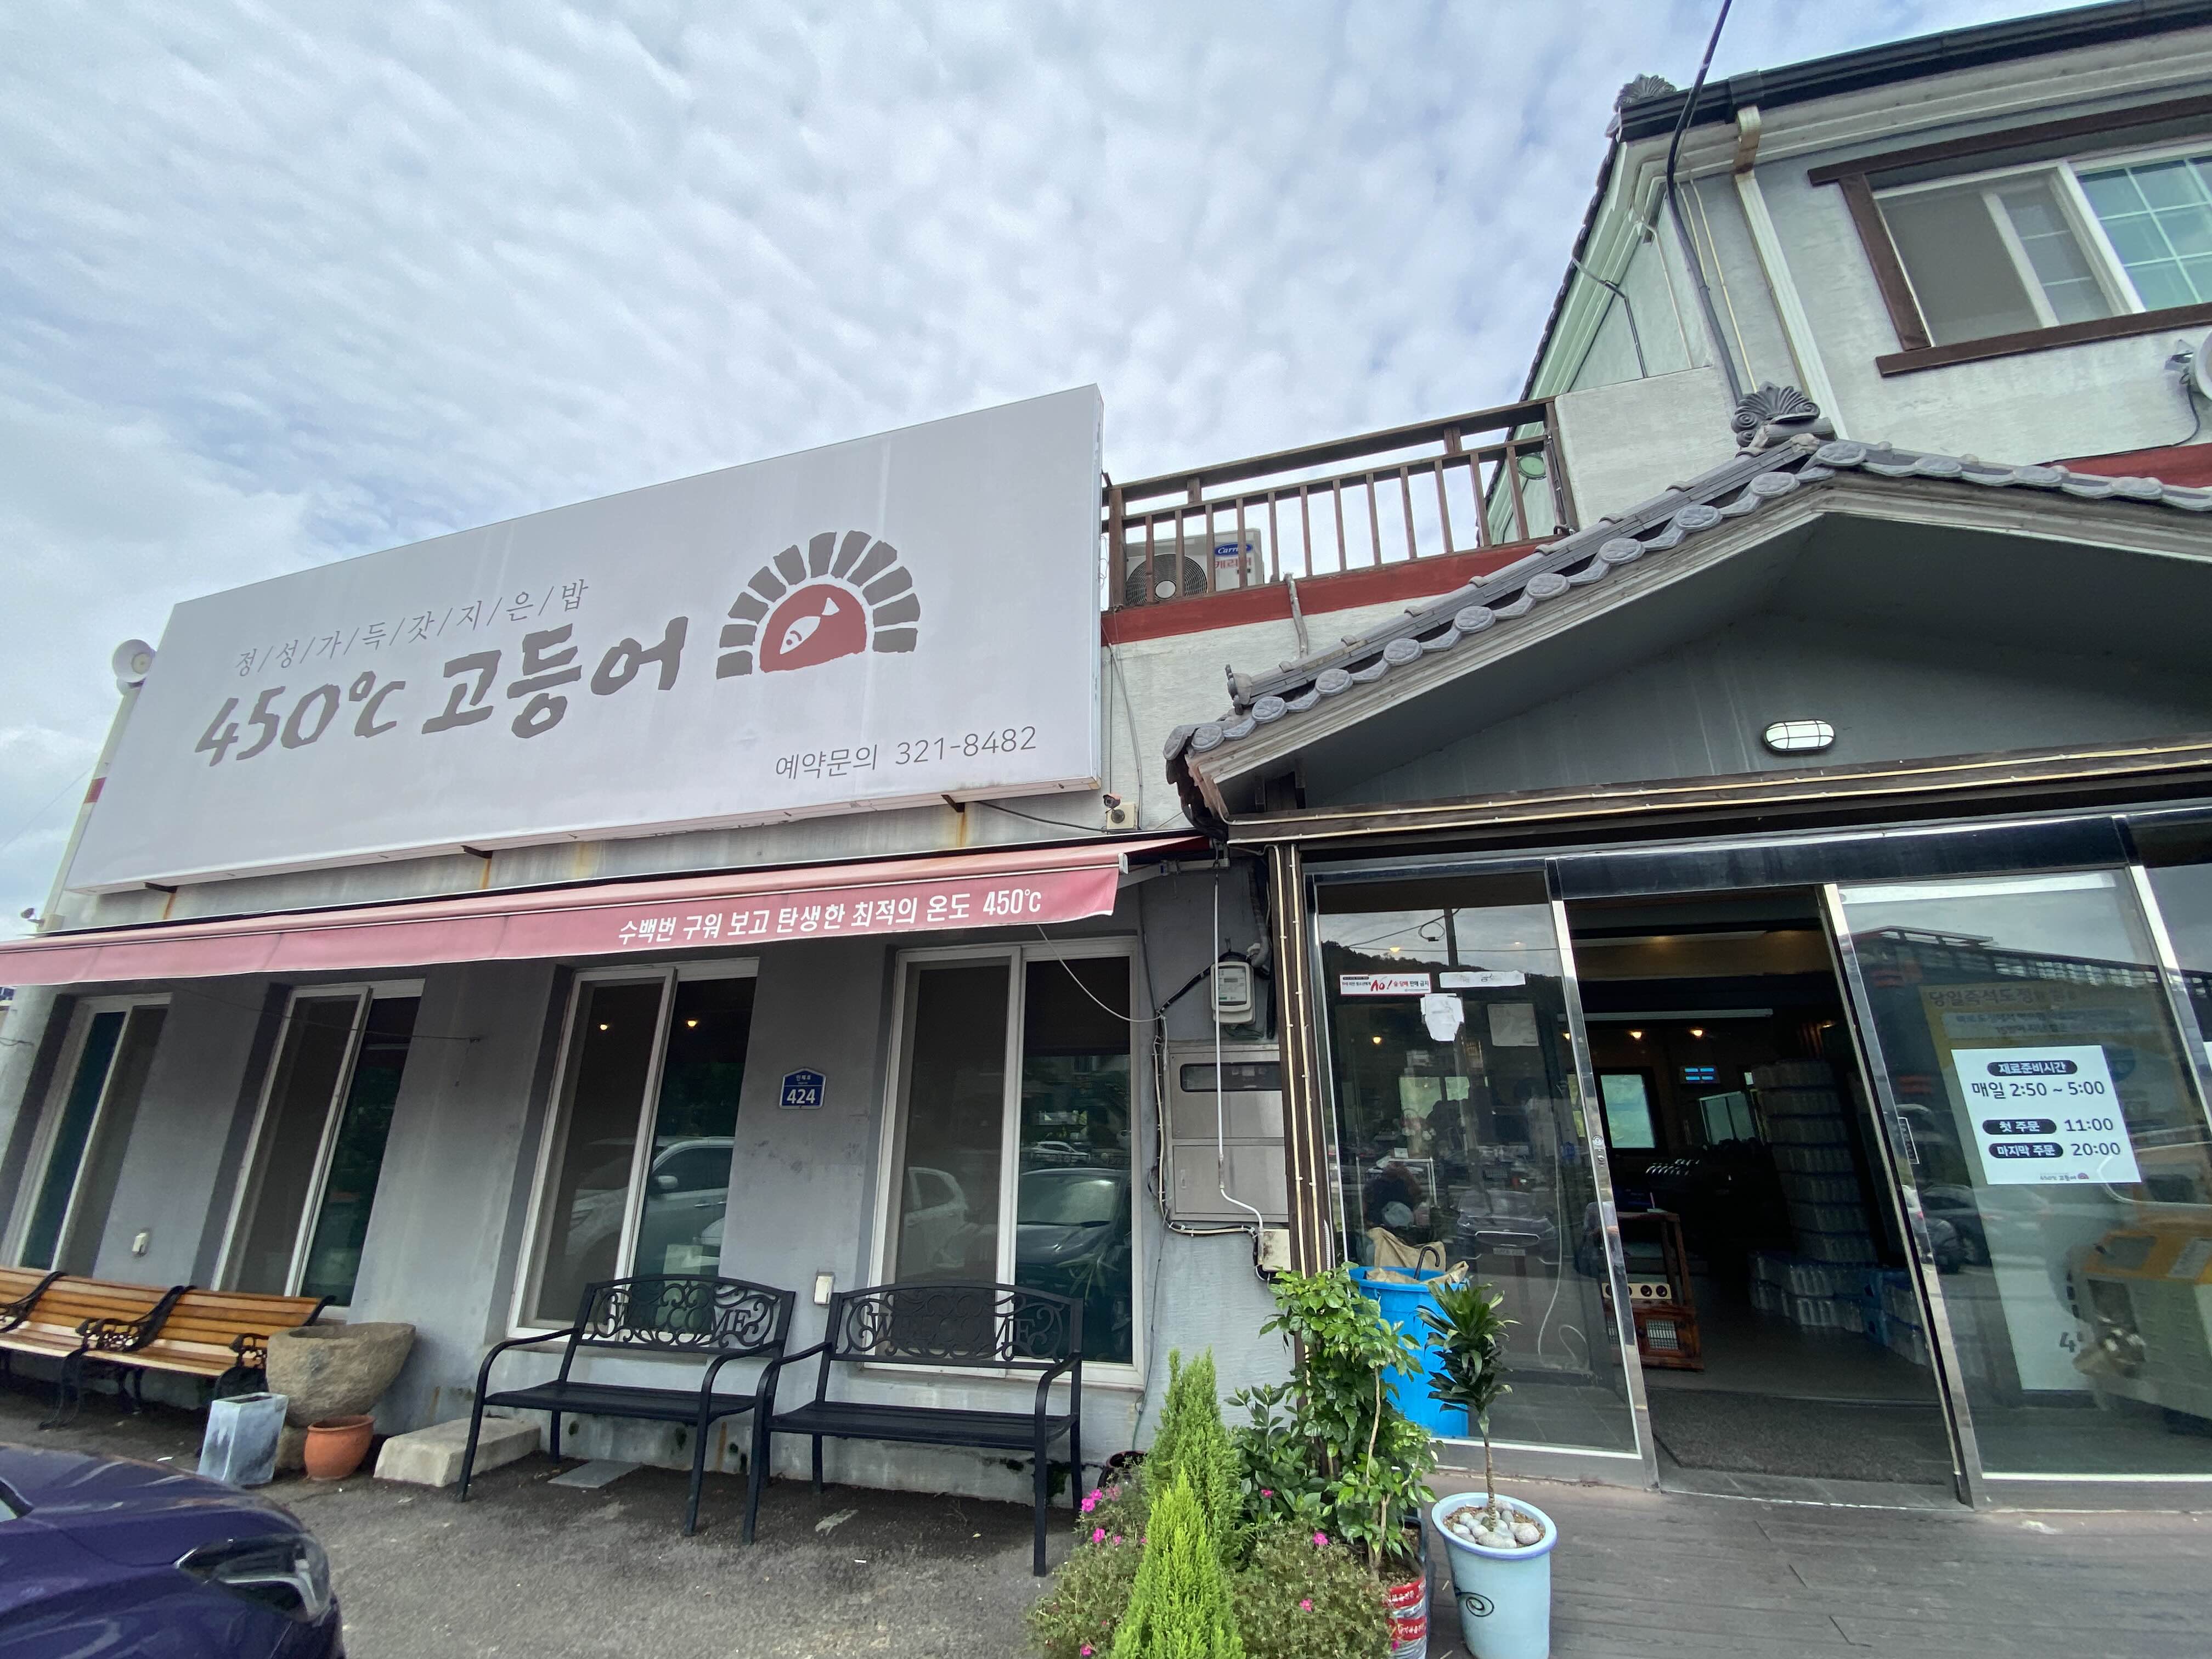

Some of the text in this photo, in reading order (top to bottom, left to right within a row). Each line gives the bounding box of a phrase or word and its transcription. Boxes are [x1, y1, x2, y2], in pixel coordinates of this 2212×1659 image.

[1218, 545, 1248, 555] Carr
[421, 616, 689, 739] 고등어
[775, 725, 1036, 780] 예약문의 321-8482
[618, 917, 676, 945] 수백번
[682, 913, 723, 940] 구워
[727, 910, 770, 936] 보고
[776, 903, 845, 934] 탄생한
[850, 897, 918, 927] 최적의
[926, 893, 971, 922] 온도
[786, 1088, 815, 1104] 424
[1971, 1082, 2006, 1099] 매일
[2009, 1082, 2047, 1097] 2:50
[2067, 1081, 2105, 1096] 5:00
[1999, 1118, 2114, 1133] 첫 주문 11:00
[1996, 1142, 2121, 1158] 마지막 주문 20:00
[616, 1301, 752, 1333] WCOME
